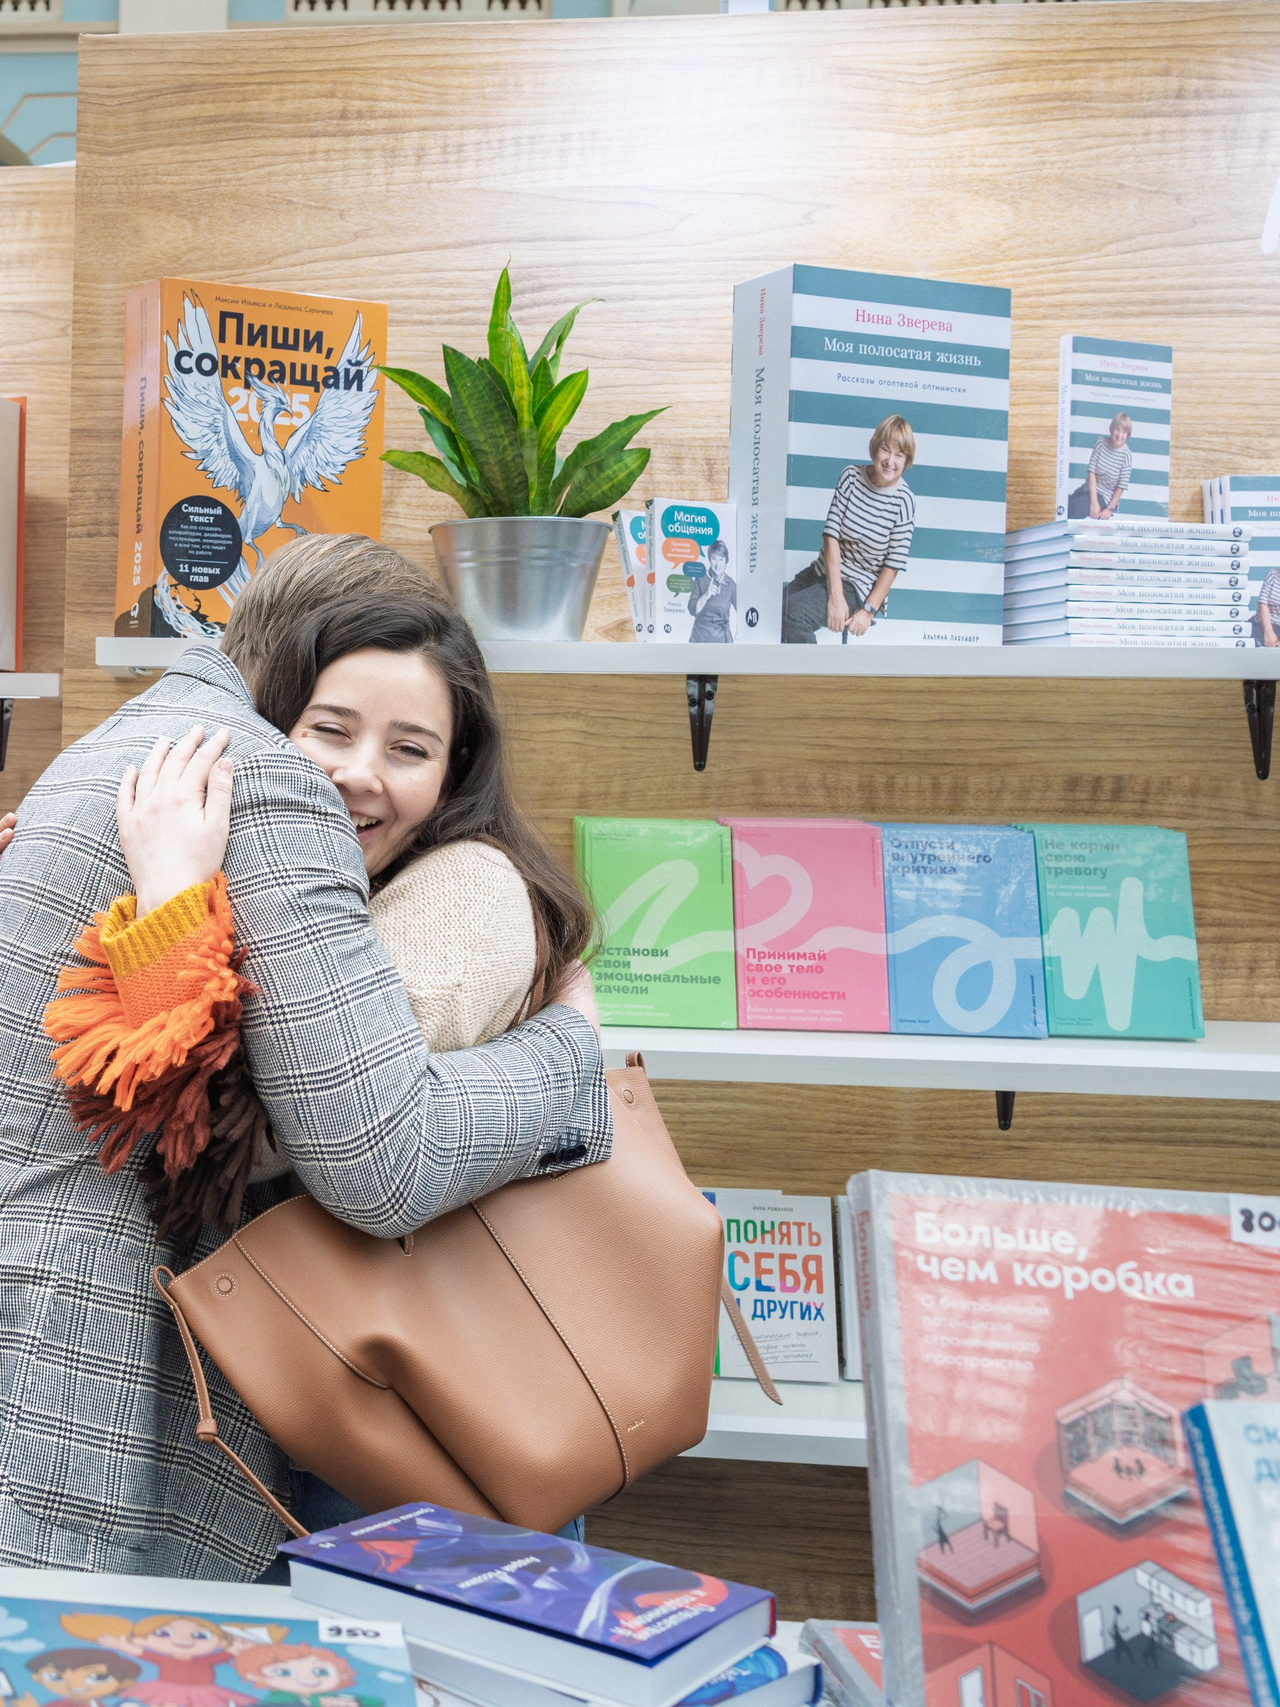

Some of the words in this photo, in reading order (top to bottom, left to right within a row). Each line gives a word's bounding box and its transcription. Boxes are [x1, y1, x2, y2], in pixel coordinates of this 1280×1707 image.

[855, 309, 893, 327] Нина
[897, 313, 954, 333] Зверева
[218, 310, 334, 360] Пиши,
[758, 316, 766, 356] Зверева
[823, 337, 854, 354] Моя
[858, 343, 931, 362] полосатая
[936, 350, 982, 367] жизнь
[173, 349, 364, 393] сокращай
[1100, 360, 1118, 368] Нина
[1121, 362, 1148, 372] Зверева
[755, 367, 765, 405] Моя
[837, 373, 874, 386] Рассказы
[878, 377, 919, 390] оголтелой
[921, 382, 967, 394] оптимистки
[1085, 373, 1100, 382] Моя
[1102, 376, 1138, 386] полосатая
[1139, 380, 1163, 389] жизнь
[137, 376, 148, 435] Пиши,
[751, 411, 762, 508] полосатая
[134, 440, 146, 535] сокращай
[181, 504, 222, 515] Сильный
[1248, 509, 1269, 518] Моя
[189, 515, 215, 523] текст
[674, 511, 707, 524] Магия
[668, 524, 713, 535] общения
[1116, 524, 1135, 532] Моя
[1137, 525, 1184, 535] полосатая
[1186, 527, 1217, 535] жизнь
[749, 513, 759, 574] жизнь
[1120, 539, 1138, 548] Моя
[1140, 541, 1185, 550] полосатая
[1187, 543, 1216, 551] жизнь
[133, 541, 142, 586] 2025
[1117, 556, 1136, 564] Моя
[1138, 558, 1184, 566] полосатая
[179, 564, 189, 573] 11
[192, 566, 220, 574] новых
[190, 575, 209, 583] глав
[890, 838, 955, 852] Отпусти
[1044, 839, 1065, 850] Не
[1071, 842, 1120, 854] корми
[891, 853, 992, 865] внутреннего
[1045, 854, 1086, 863] свою
[892, 865, 957, 877] критика
[1045, 866, 1108, 880] тревогу
[746, 949, 827, 962] Принимай
[595, 959, 631, 969] свои
[746, 963, 783, 973] свое
[788, 964, 824, 974] тело
[595, 972, 721, 985] эмоциональные
[746, 976, 756, 985] и
[761, 976, 787, 986] его
[595, 985, 649, 995] качели
[747, 987, 847, 1000] особенности
[726, 1218, 822, 1247] ПОНЯТЬ
[914, 1211, 1089, 1261] Больше,
[727, 1250, 824, 1295] СЕБЯ
[916, 1254, 998, 1285] чем
[1013, 1260, 1195, 1300] коробка
[751, 1298, 825, 1321] ДРУГИХ
